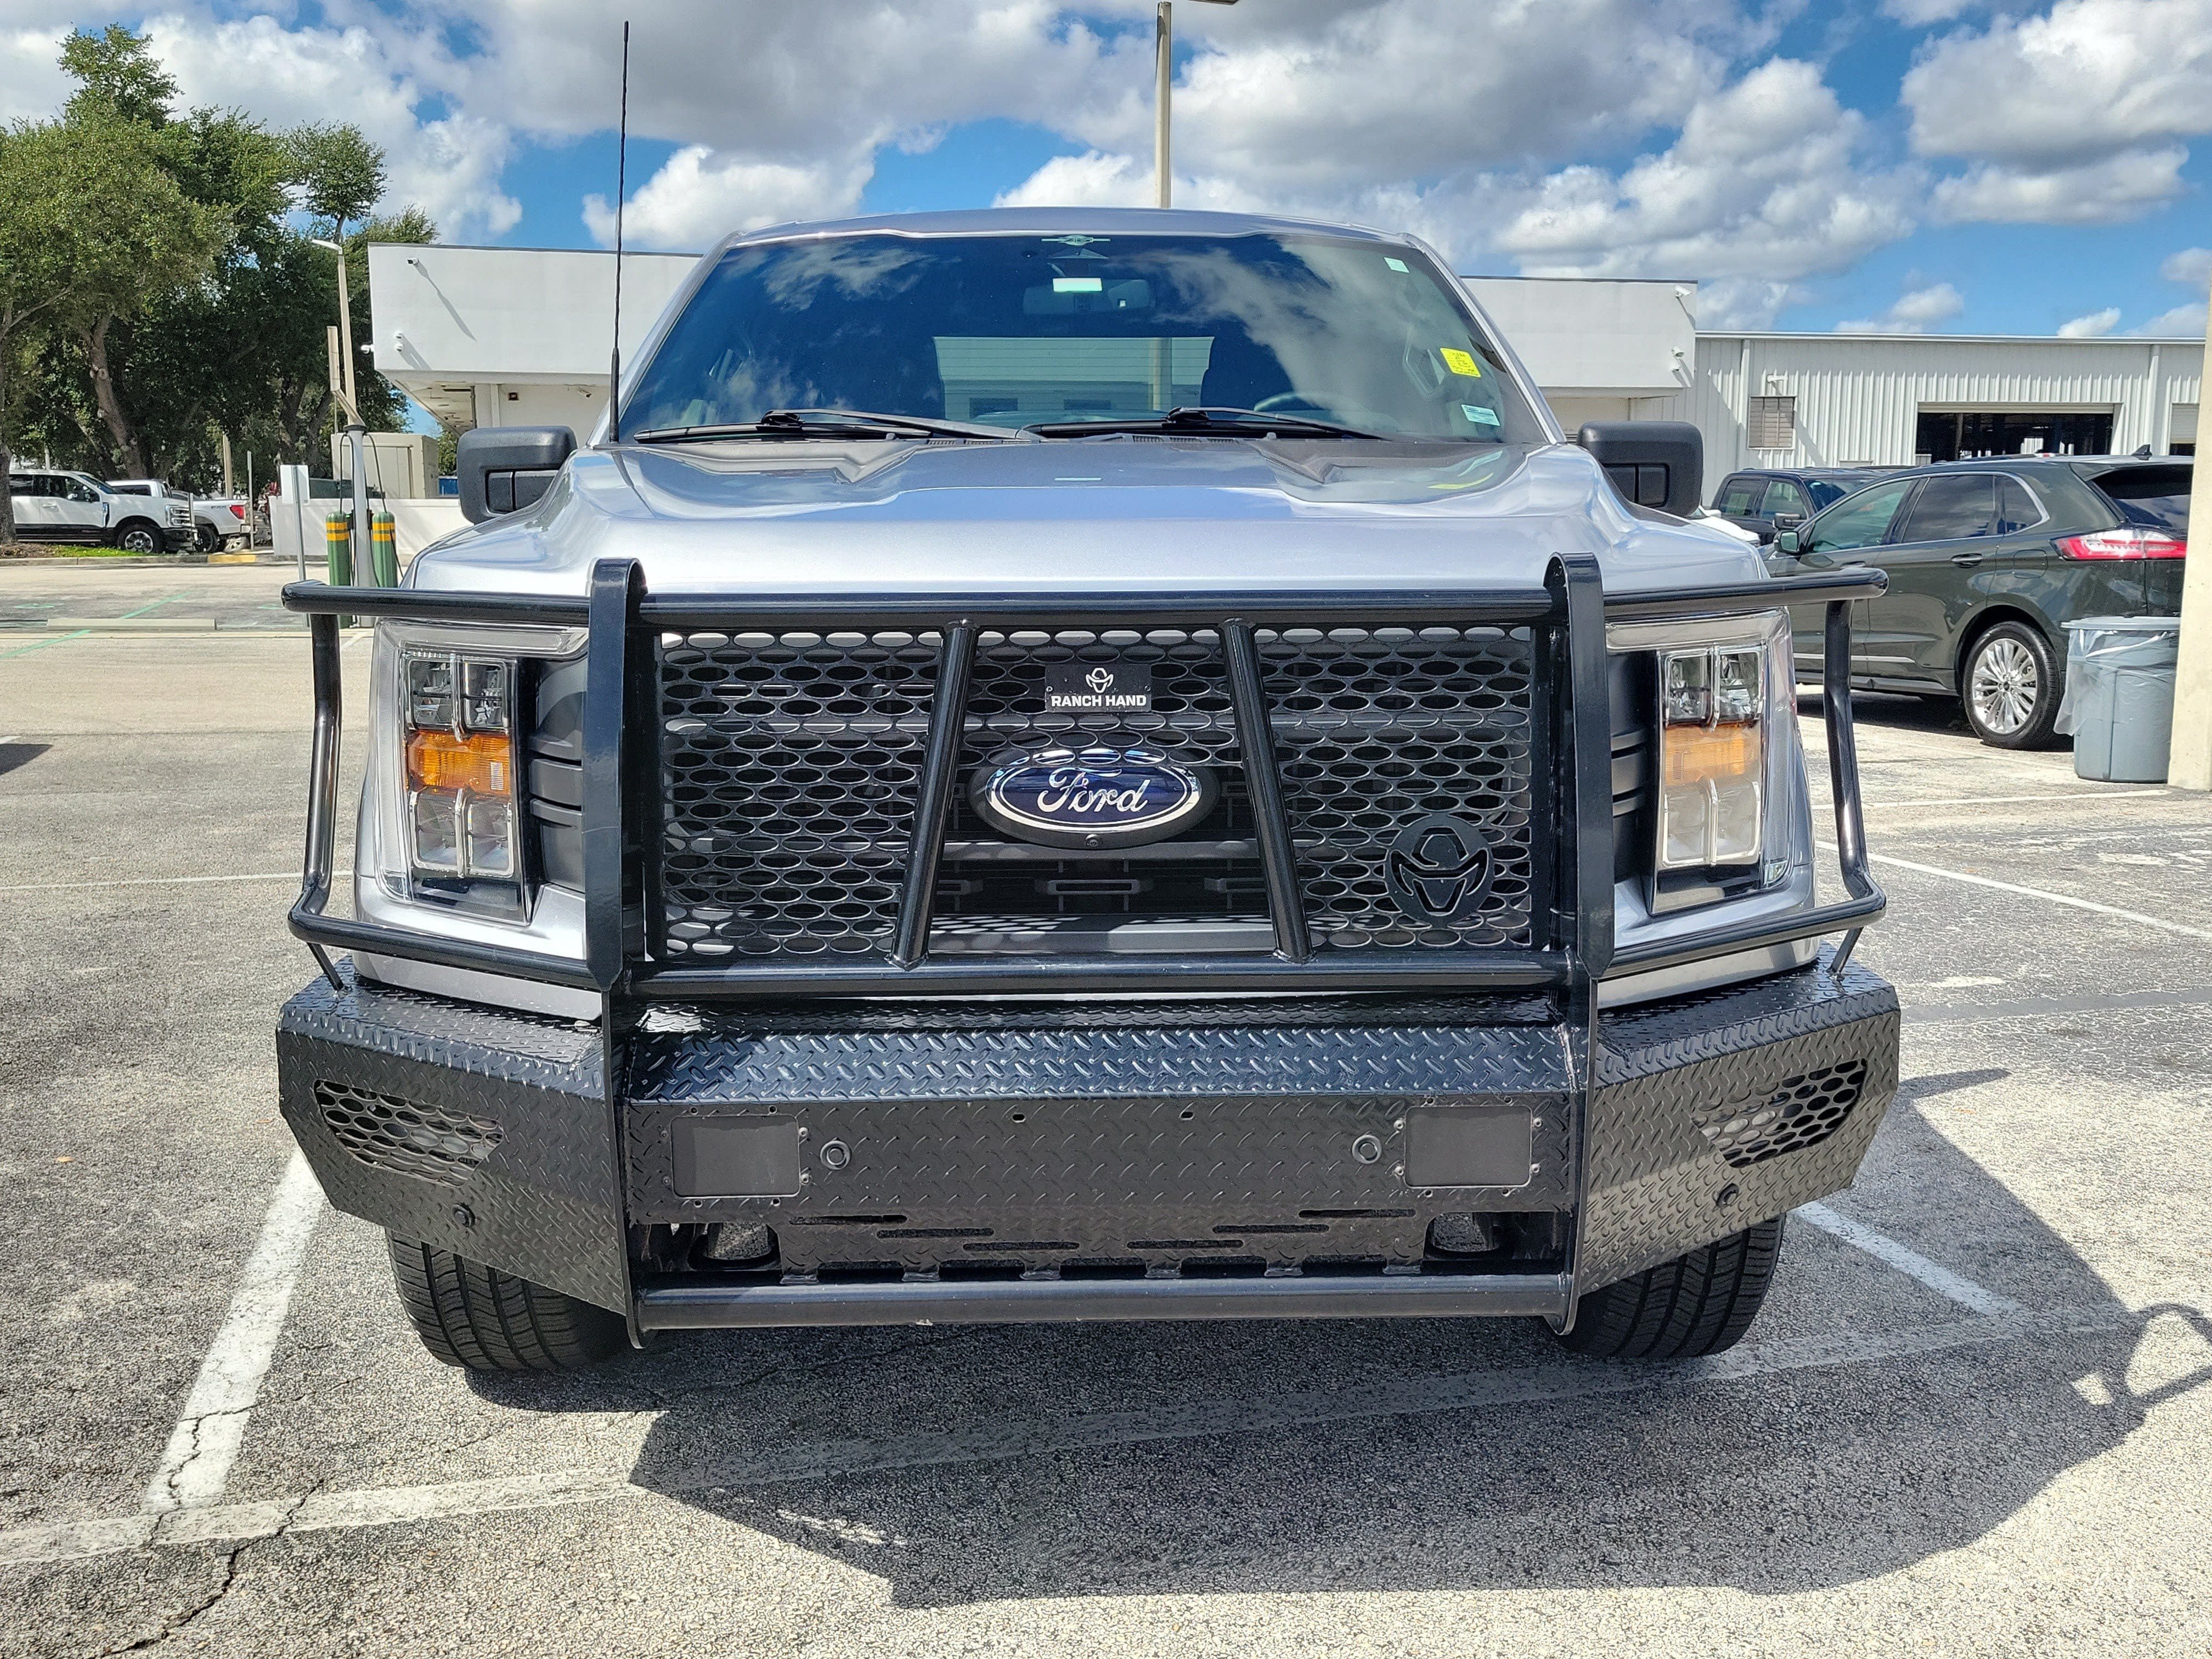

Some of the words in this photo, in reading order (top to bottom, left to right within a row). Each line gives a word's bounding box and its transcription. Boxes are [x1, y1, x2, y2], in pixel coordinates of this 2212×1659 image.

[1051, 695, 1102, 707] RANCH
[1105, 695, 1147, 707] HAND
[1037, 767, 1150, 812] Ford
